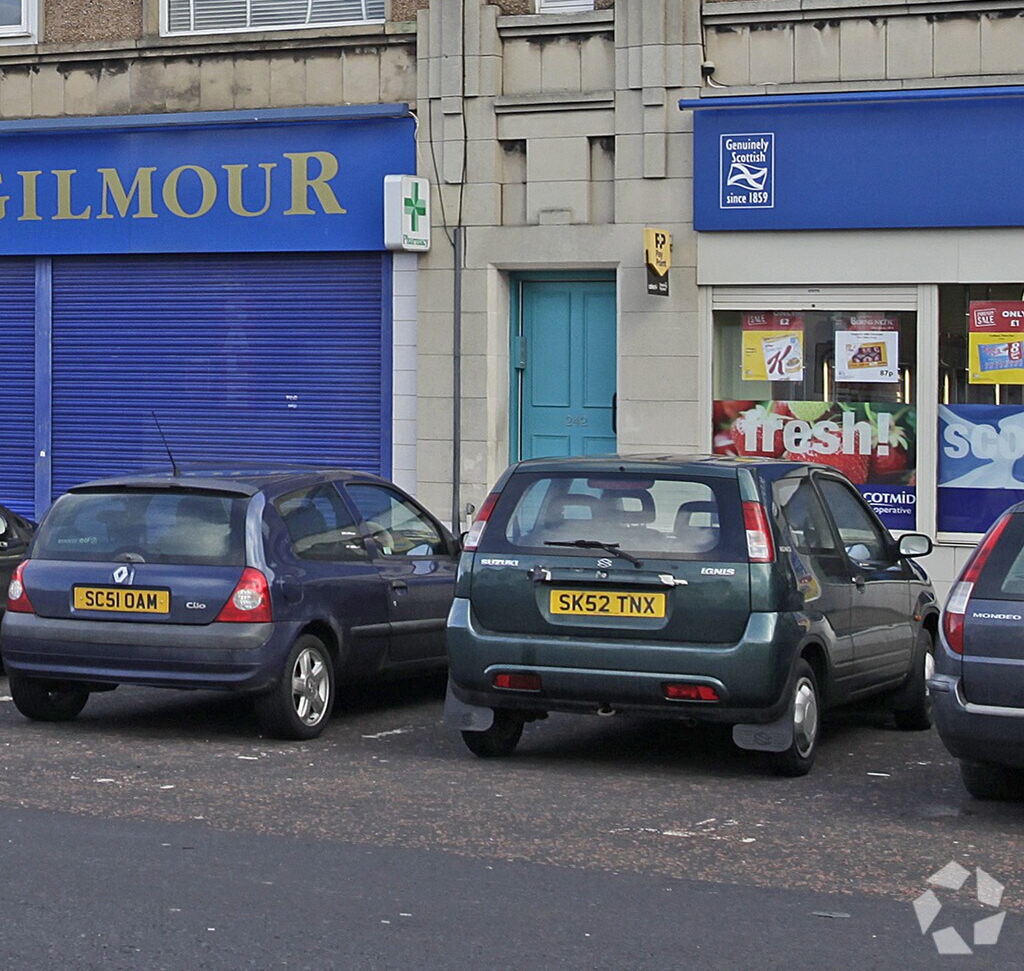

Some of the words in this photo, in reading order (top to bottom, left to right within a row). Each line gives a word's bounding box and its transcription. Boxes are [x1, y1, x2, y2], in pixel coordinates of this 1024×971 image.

[725, 138, 769, 152] Genuinely
[731, 151, 766, 163] Scottish
[726, 193, 747, 204] since
[749, 192, 768, 203] 1859
[977, 315, 995, 325] SALE
[740, 411, 891, 456] fresh!
[480, 558, 519, 567] SUZUKI
[700, 567, 736, 576] IGNIS
[85, 591, 120, 608] SC51
[124, 593, 157, 610] OAM
[185, 601, 207, 609] Clio
[559, 594, 610, 613] SK52
[617, 595, 655, 614] TNX
[972, 612, 1022, 620] MONDEO
